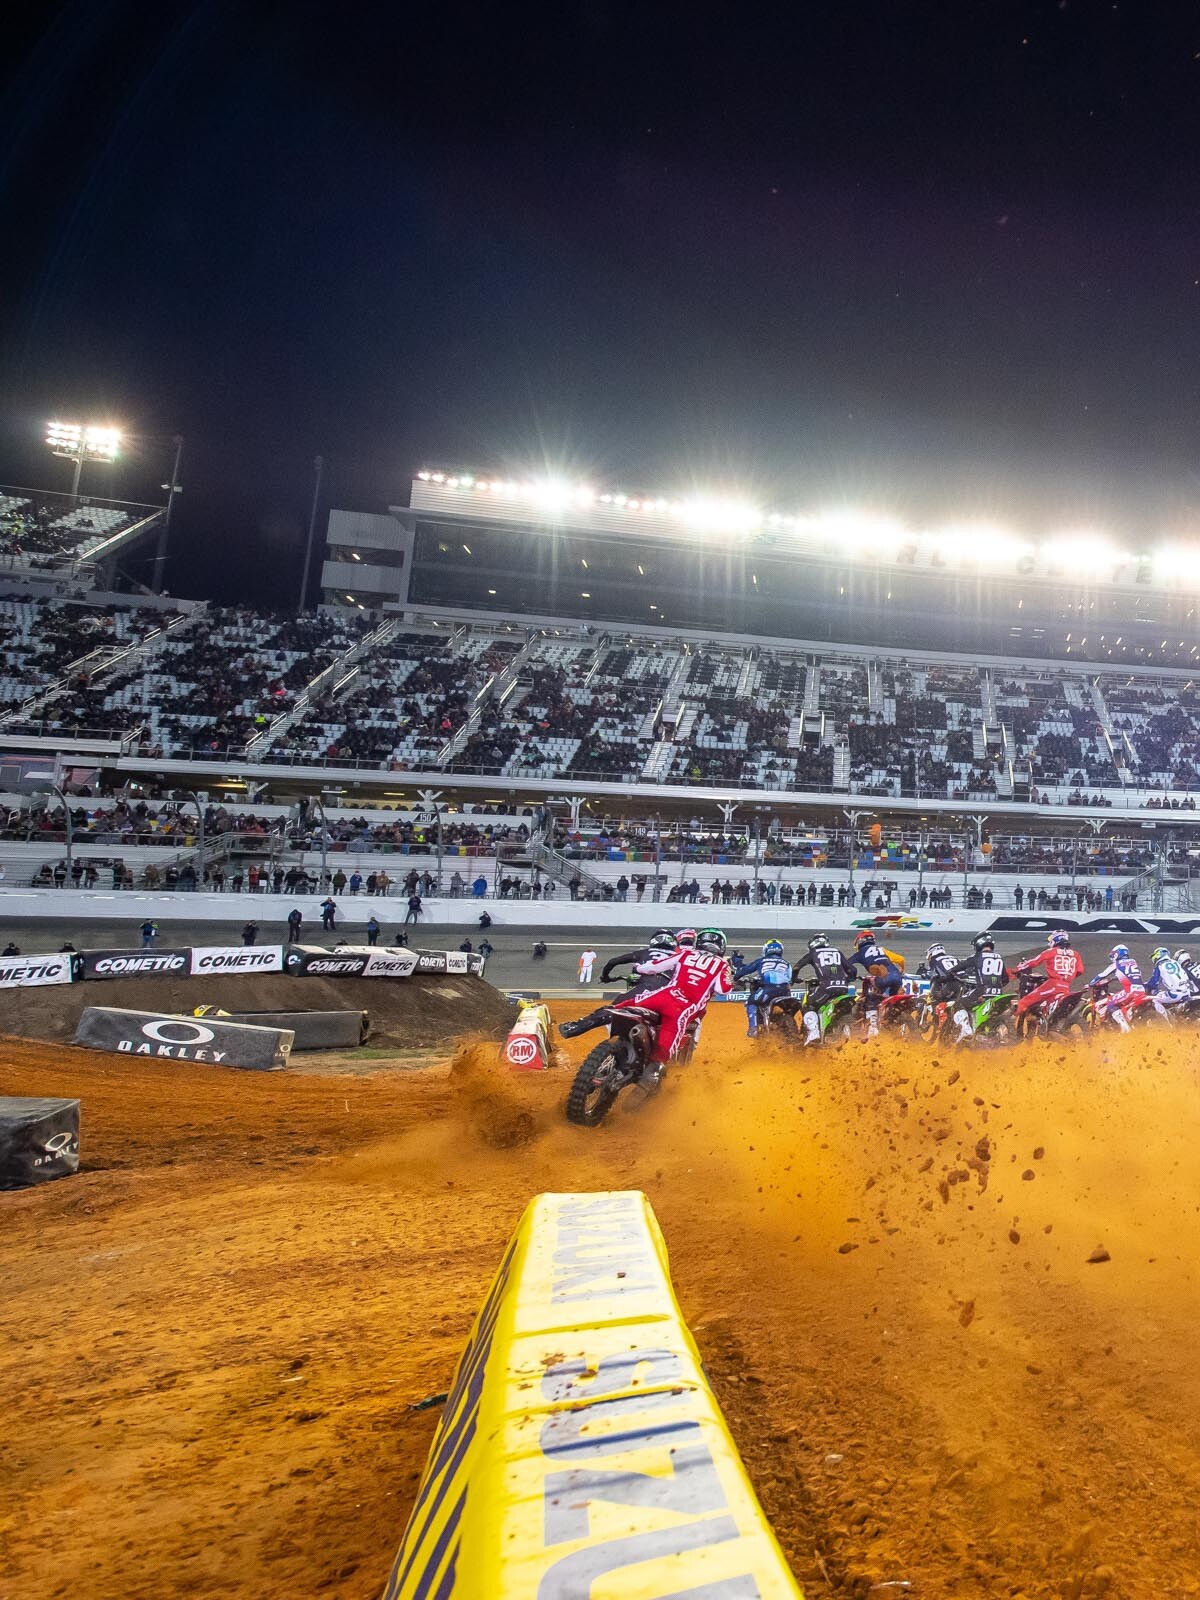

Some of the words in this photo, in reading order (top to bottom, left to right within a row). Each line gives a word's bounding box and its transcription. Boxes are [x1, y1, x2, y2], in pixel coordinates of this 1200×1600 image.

[95, 956, 185, 972] COMETIC
[198, 953, 275, 968] COMETIC
[306, 959, 364, 972] COMETIC
[369, 959, 414, 971] COMETIC
[817, 952, 842, 967] 150
[981, 958, 1003, 975] 80
[117, 1040, 227, 1062] OAKLEY
[512, 1045, 532, 1057] RM
[551, 1198, 659, 1305] SUZUKI
